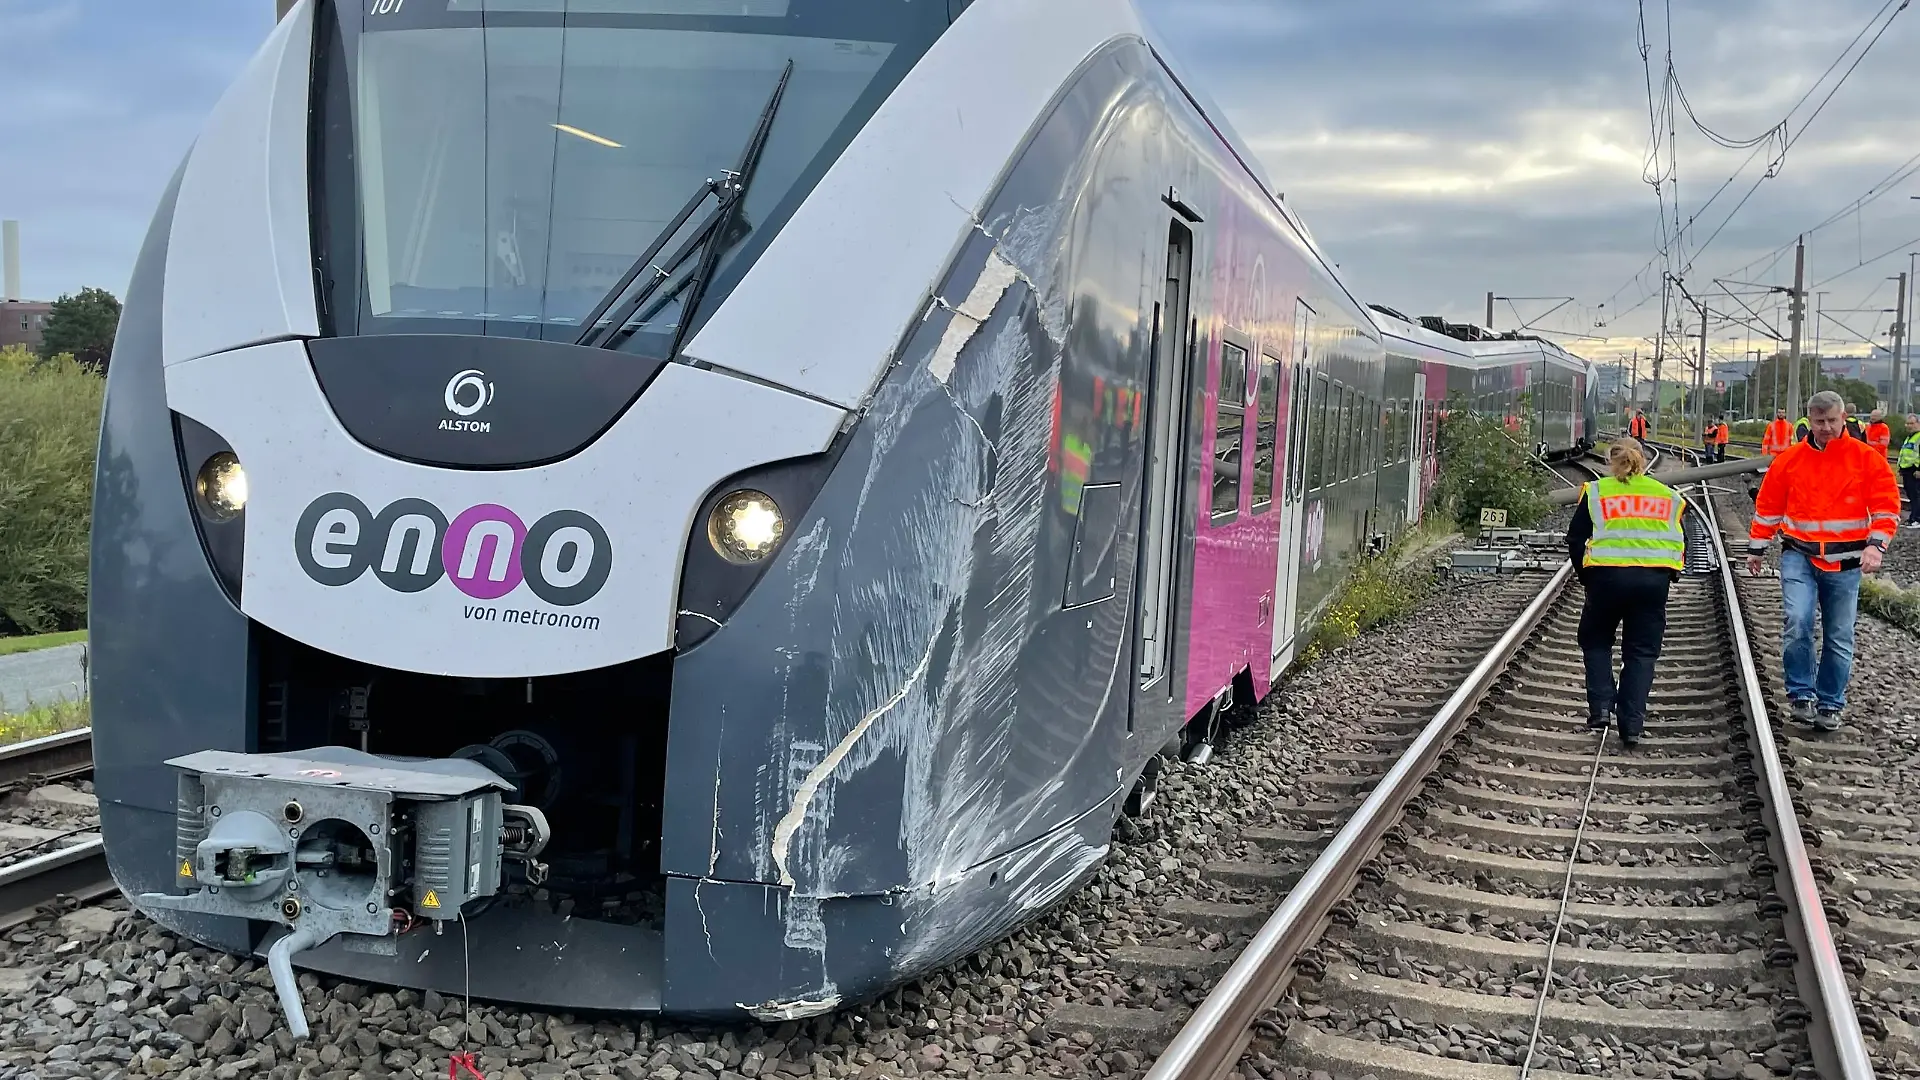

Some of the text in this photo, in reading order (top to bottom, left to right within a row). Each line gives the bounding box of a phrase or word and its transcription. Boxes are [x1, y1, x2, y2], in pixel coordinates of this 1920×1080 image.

[438, 419, 491, 433] ALSTOM
[1482, 510, 1505, 523] 263
[1604, 495, 1669, 519] POLIZEI
[308, 506, 597, 589] enno
[464, 605, 600, 630] von metronom
